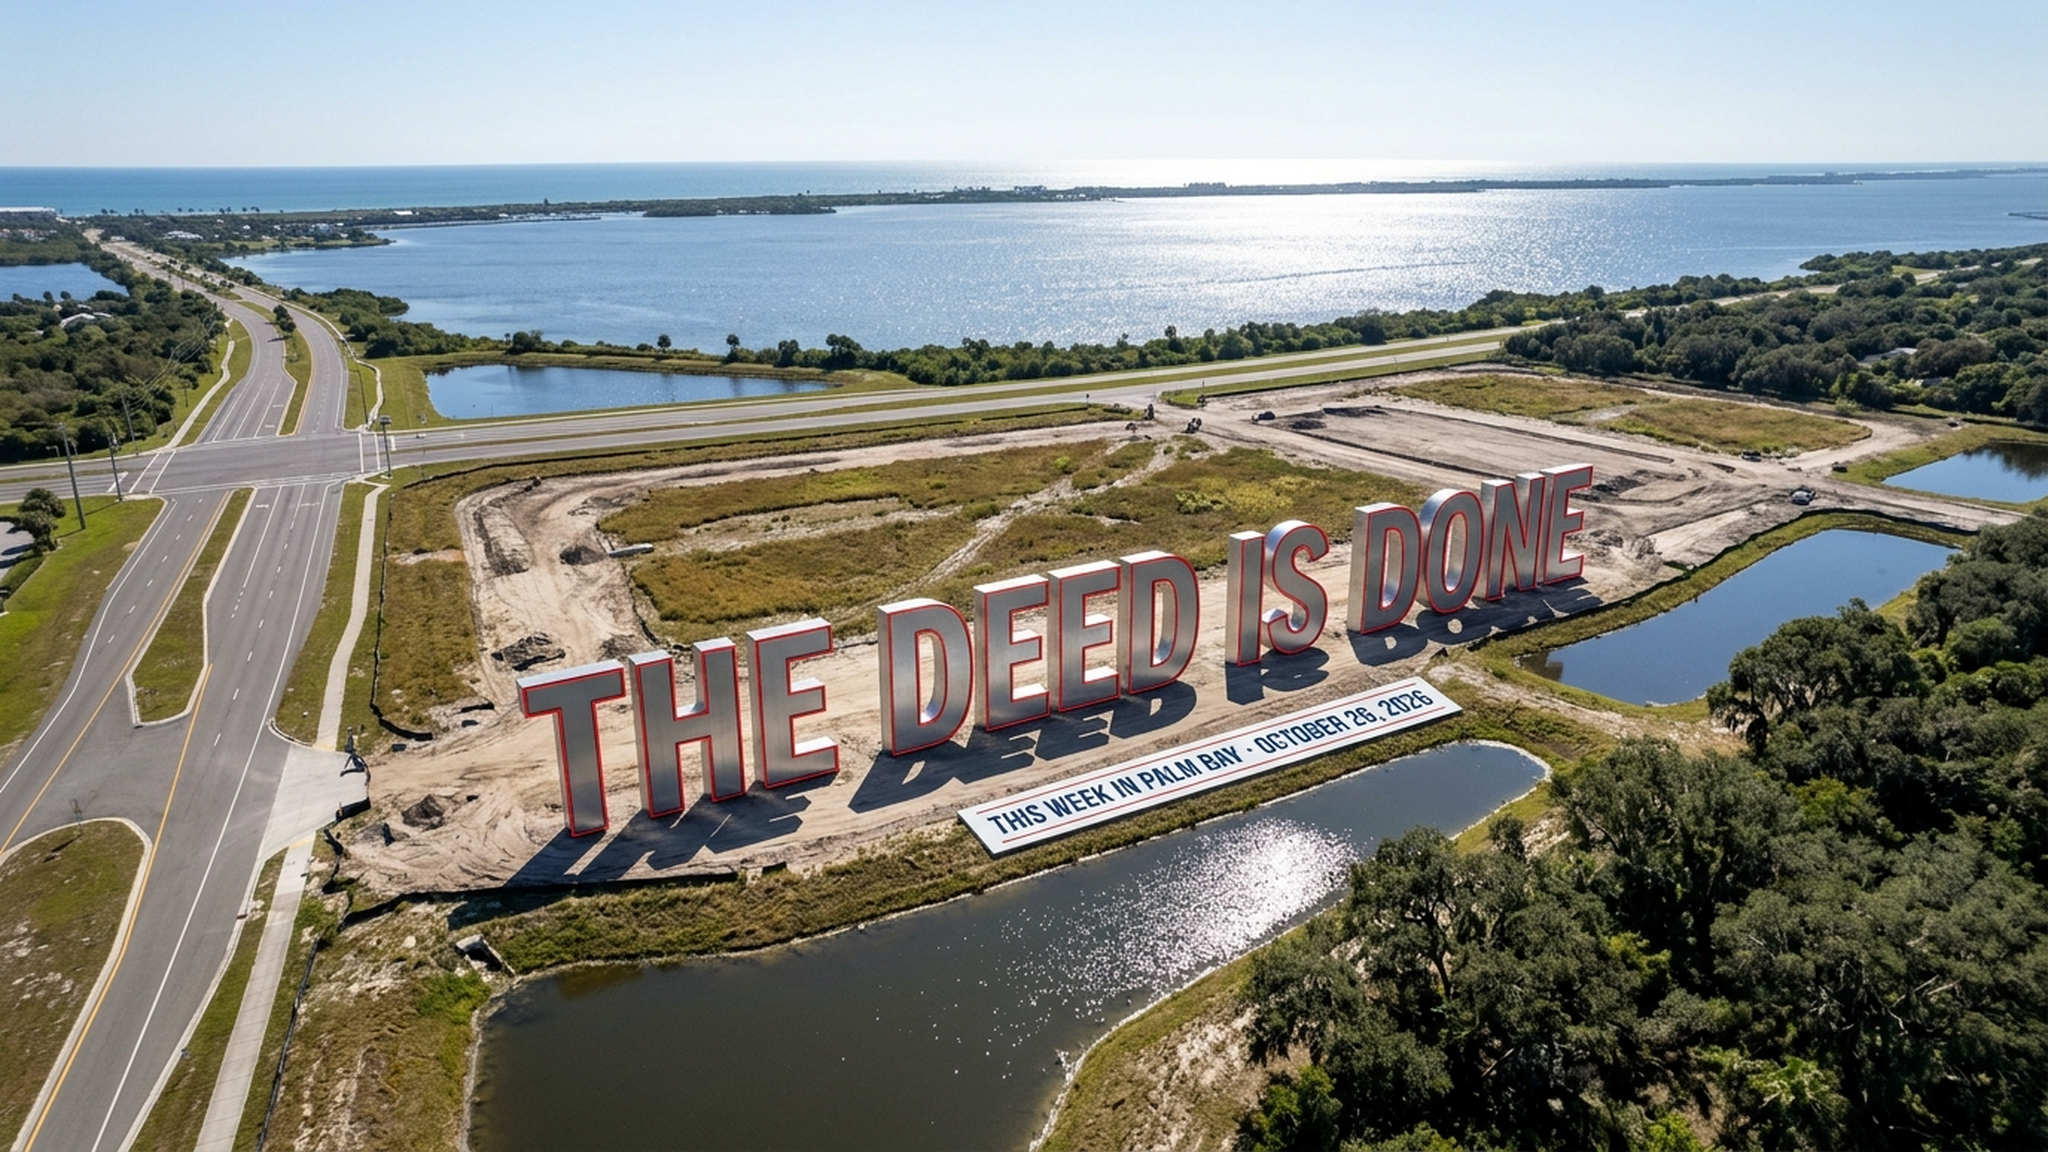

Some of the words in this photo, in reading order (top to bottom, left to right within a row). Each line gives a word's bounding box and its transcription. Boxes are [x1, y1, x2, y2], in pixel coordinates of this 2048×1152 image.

[516, 618, 840, 837] THE
[877, 550, 1200, 757] DEED
[1225, 520, 1329, 666] IS
[1347, 463, 1594, 634] DONE
[986, 804, 1047, 835] THIS
[1043, 784, 1115, 818] WEEK
[1109, 776, 1142, 798] IN
[1136, 758, 1203, 790] PALM
[1196, 745, 1243, 771] BAY
[1253, 715, 1351, 754] OCTOBER
[1343, 707, 1388, 727] 26,
[1377, 689, 1434, 717] 2026
